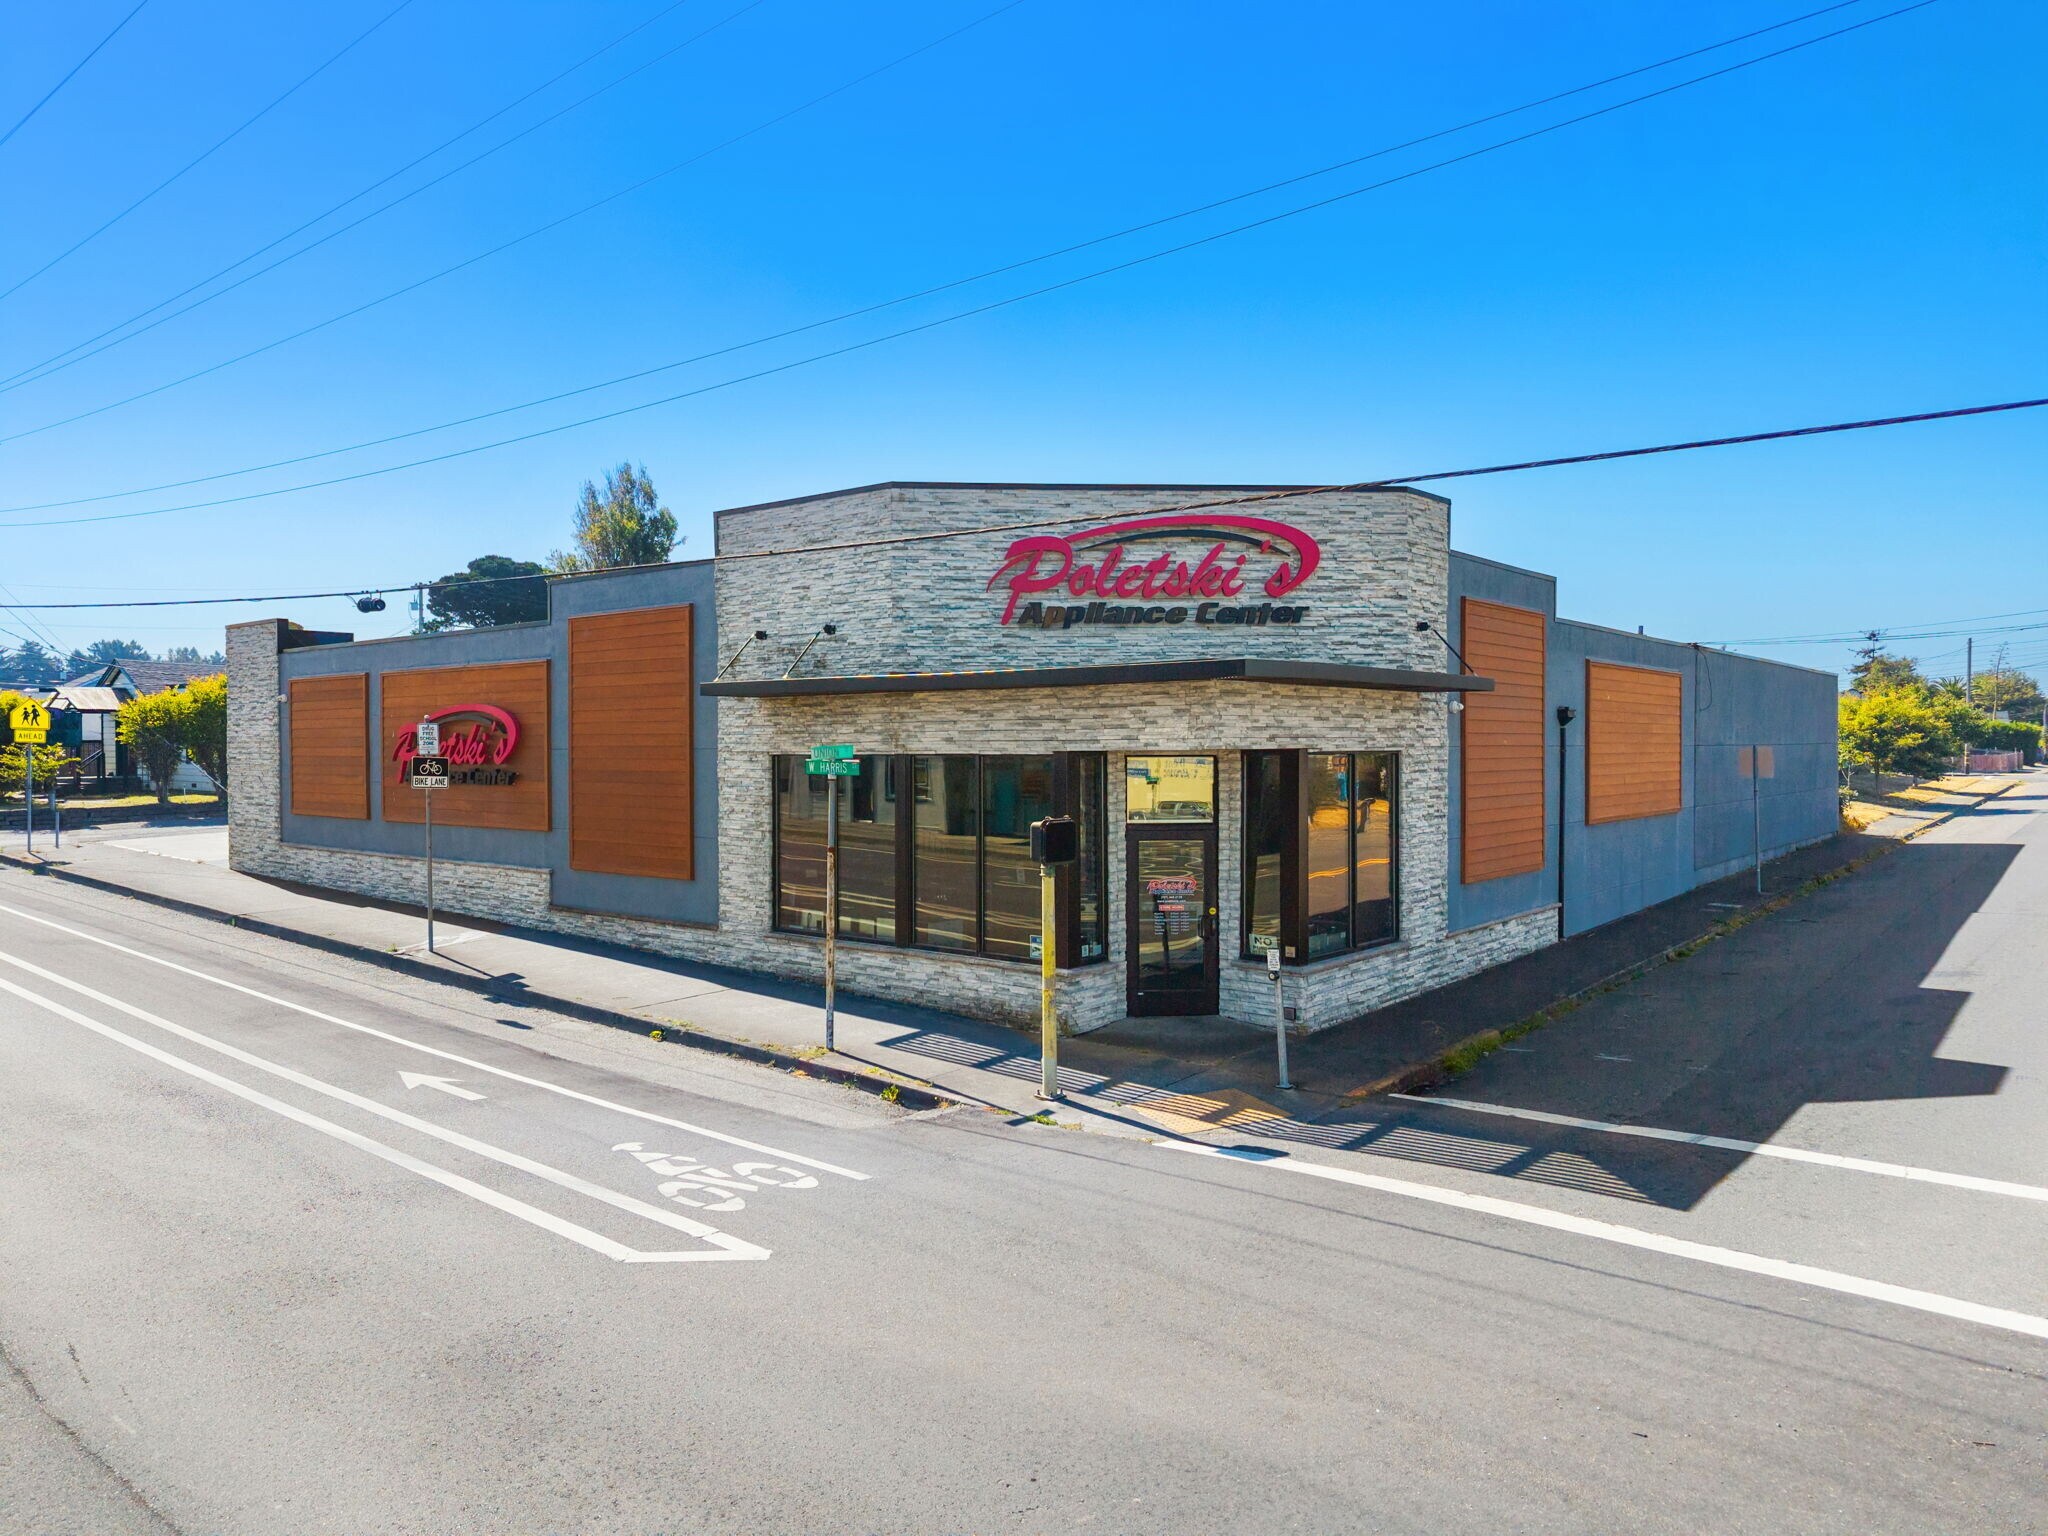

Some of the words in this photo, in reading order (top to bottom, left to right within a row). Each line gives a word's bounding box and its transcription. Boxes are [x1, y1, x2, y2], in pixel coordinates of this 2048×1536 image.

[986, 515, 1320, 625] Poletski's
[1018, 601, 1188, 628] Appliance
[1195, 601, 1310, 625] Center
[18, 732, 43, 740] AHEAD
[393, 703, 518, 784] Petski's
[813, 748, 839, 759] UNION
[809, 762, 815, 772] W
[820, 762, 847, 773] HARRIS
[414, 777, 428, 786] BIKE
[430, 777, 446, 786] LANE
[466, 770, 515, 785] Center
[1254, 936, 1273, 946] NO
